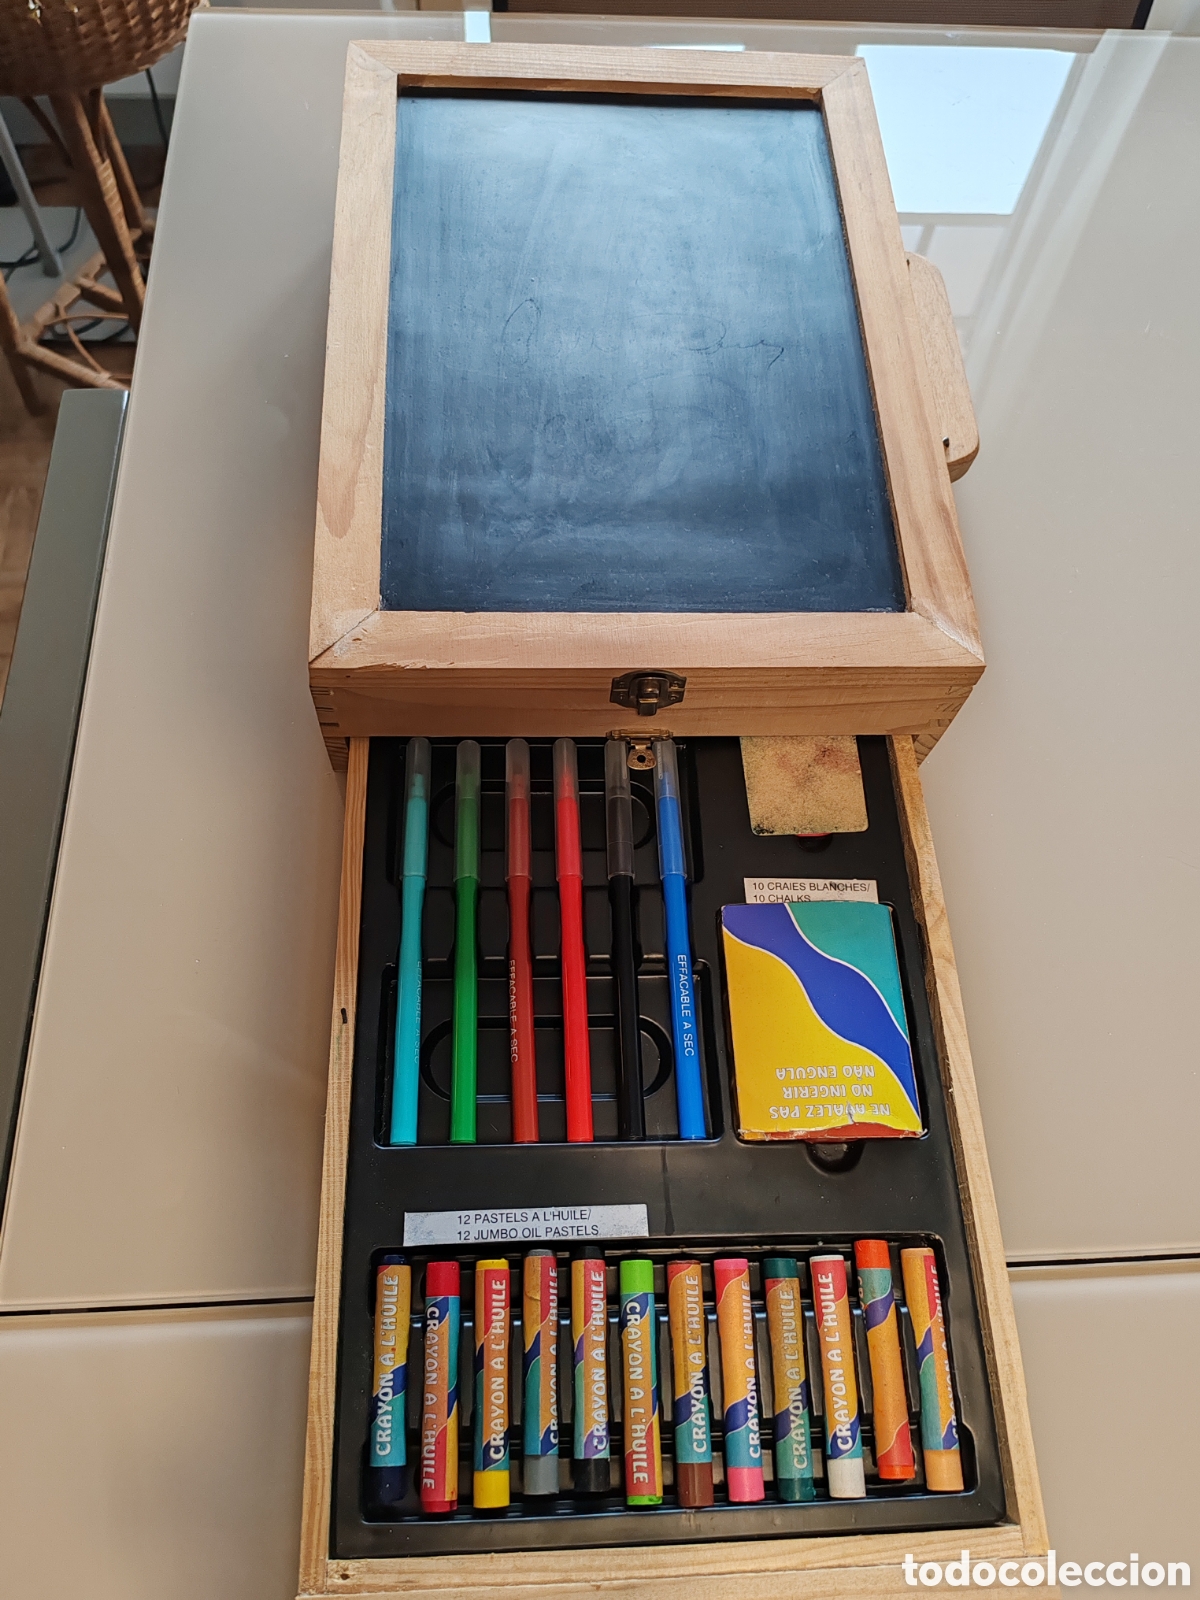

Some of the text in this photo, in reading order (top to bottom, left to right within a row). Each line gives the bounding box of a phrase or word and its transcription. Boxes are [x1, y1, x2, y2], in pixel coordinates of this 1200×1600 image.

[752, 882, 870, 892] 10 CRAIES BLANCHES/
[753, 894, 811, 902] 10 CHALKS
[508, 959, 517, 1024] EFFACABLE
[677, 954, 695, 1057] EFFACABLE A SEC
[510, 1038, 519, 1063] SEC
[775, 1065, 837, 1080] ENGULA
[769, 1105, 801, 1119] PAS
[782, 1084, 873, 1099] NO INGERIR
[870, 1103, 890, 1116] NE
[457, 1208, 592, 1225] 12 PASTELS A L'HUILE/
[457, 1224, 599, 1241] 12 JUMBO OIL PASTELS
[376, 1274, 399, 1456] CRAYON A L'HUILE
[490, 1279, 506, 1460] CRAYON A L'HUILE
[590, 1270, 608, 1450] CRAYON A L'HUILE
[626, 1301, 649, 1484] CRAYON A L'HUILE
[685, 1274, 707, 1453] CRAYON A L'HUILE
[779, 1288, 808, 1470] CRAYON A L'HUILE
[818, 1272, 853, 1451] CRAYON A L'HUILE
[422, 1306, 440, 1490] CRAYON A L'HUILE
[746, 1377, 760, 1459] CRAYON
